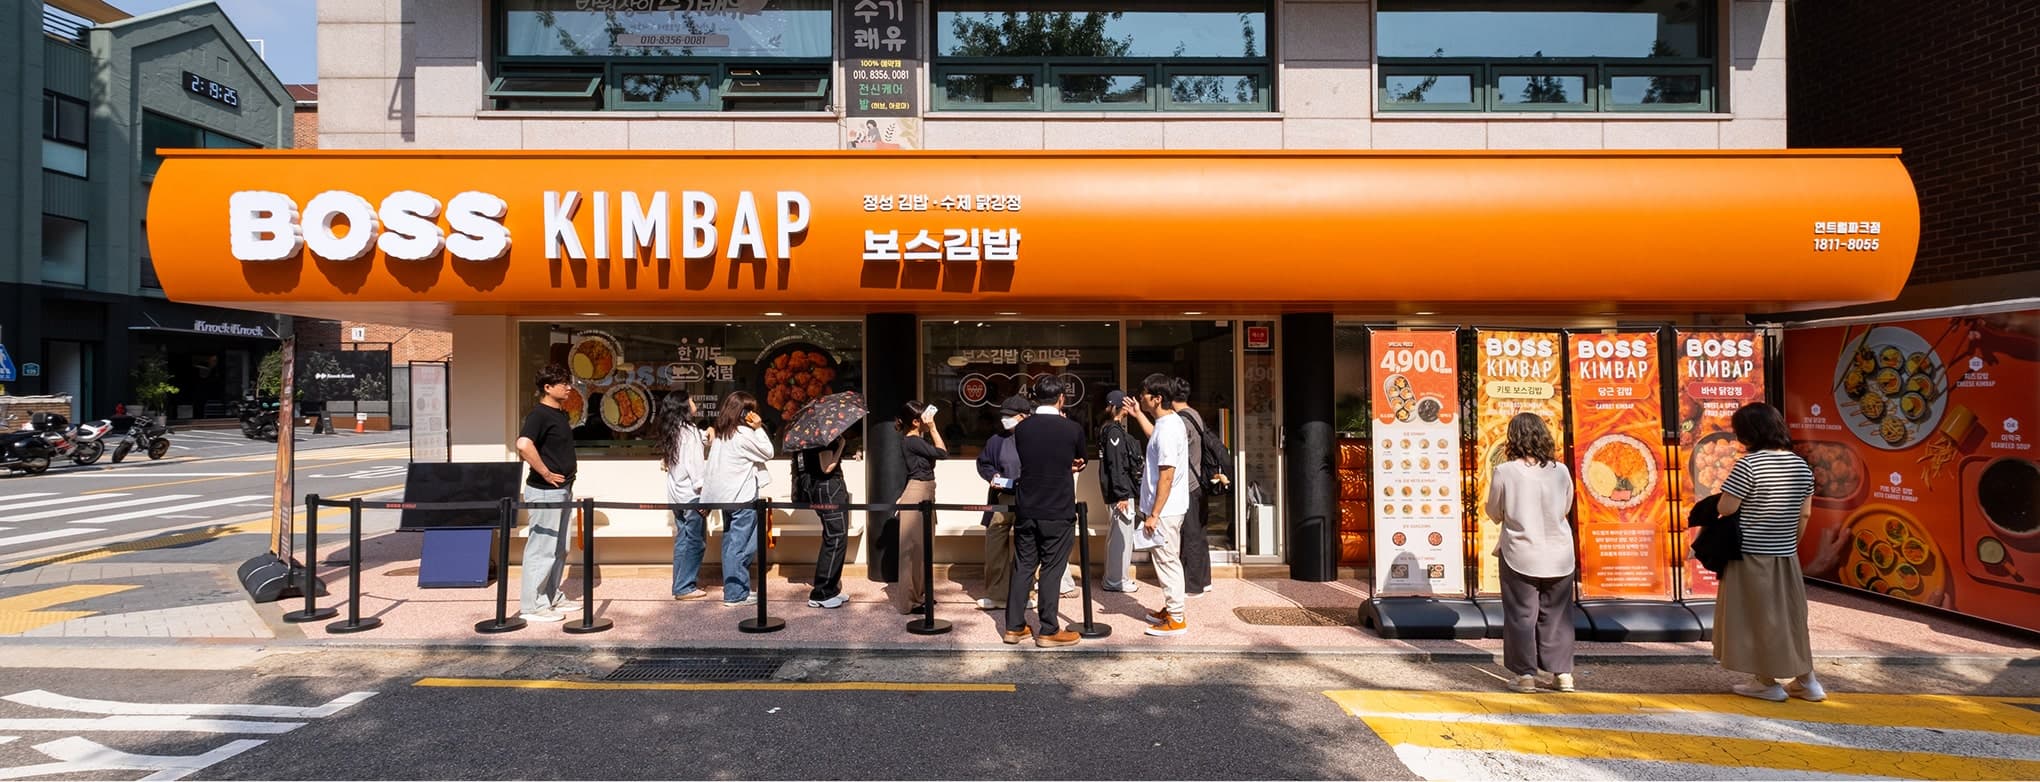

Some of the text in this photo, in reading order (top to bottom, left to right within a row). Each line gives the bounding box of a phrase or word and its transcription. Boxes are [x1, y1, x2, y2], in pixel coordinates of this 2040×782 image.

[640, 34, 707, 46] 010-8356-0081
[853, 26, 907, 52] 쾌유
[859, 84, 903, 96] 전신케어
[863, 193, 1022, 211] 정성 김밥 수제 닭강정
[230, 190, 811, 262] BOSS KIMBAP
[862, 228, 1021, 261] 보스김밥
[1813, 238, 1880, 251] 1811-8055
[677, 345, 692, 361] 한
[1486, 338, 1553, 357] BOSS
[1578, 340, 1648, 358] BOSS
[1686, 338, 1753, 357] BOSS
[1380, 349, 1446, 373] 4,900
[1487, 359, 1553, 378] KIMBAP
[1580, 360, 1648, 379] KIMBAP
[1688, 359, 1754, 378] KIMBAP
[706, 365, 735, 381] 처럼
[1496, 385, 1543, 396] 키토 보스김밥
[1598, 386, 1633, 397] 당근 김밥
[1701, 386, 1743, 396] 바삭 닭강정
